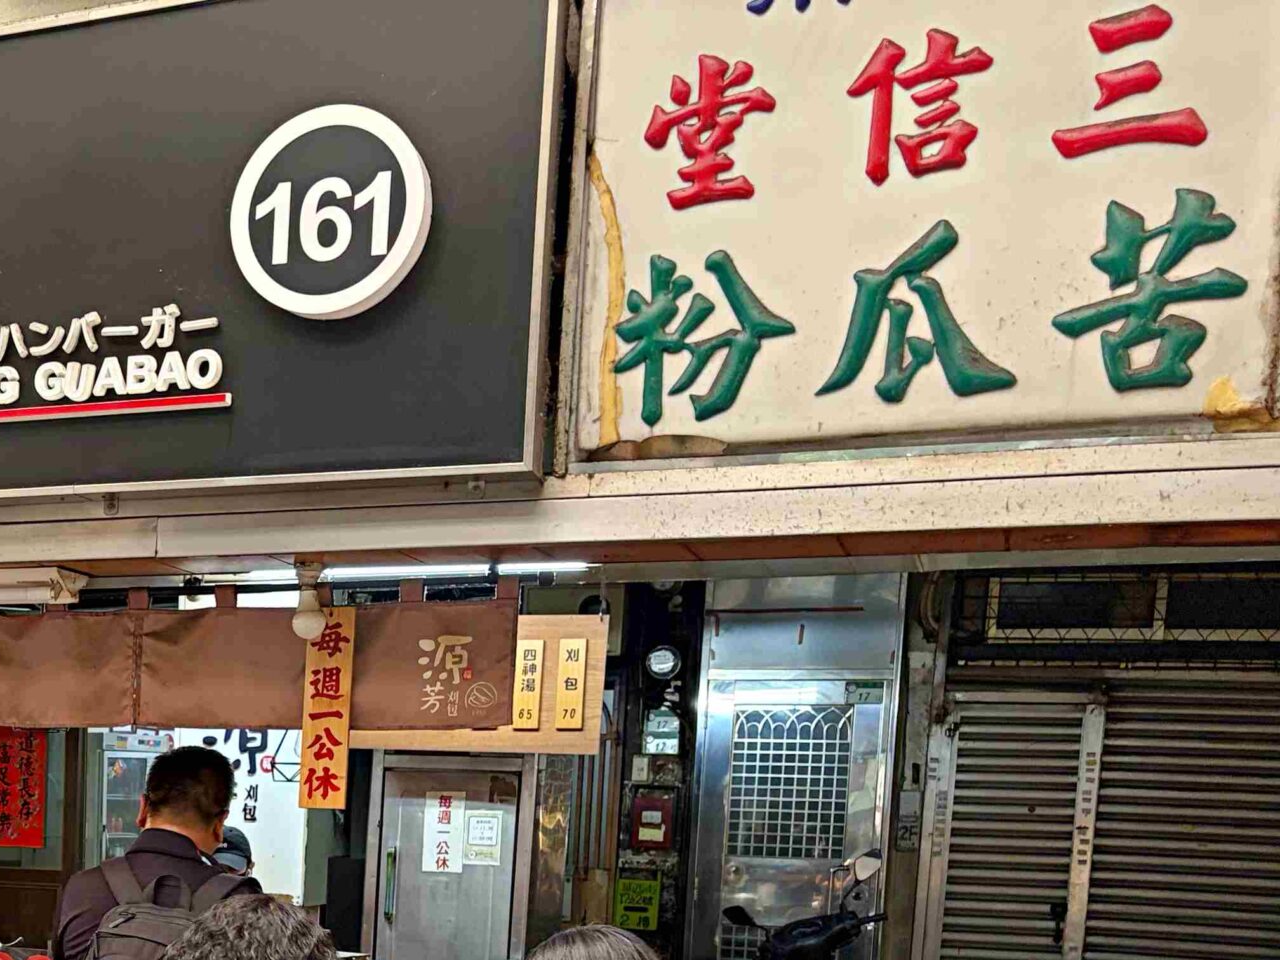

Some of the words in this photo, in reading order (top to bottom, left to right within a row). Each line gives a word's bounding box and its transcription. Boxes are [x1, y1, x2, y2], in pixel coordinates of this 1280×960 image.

[253, 169, 395, 267] 161
[612, 187, 1249, 427] 苦瓜粉
[33, 348, 224, 402] GUABAO
[417, 634, 474, 714] 源芳
[520, 648, 538, 693] 四神湯
[564, 647, 581, 692] 刈包
[302, 620, 352, 801] 每週一公休
[518, 707, 534, 721] 65
[561, 707, 578, 720] 70
[242, 784, 259, 822] 刈包
[434, 795, 454, 871] 每週一公休
